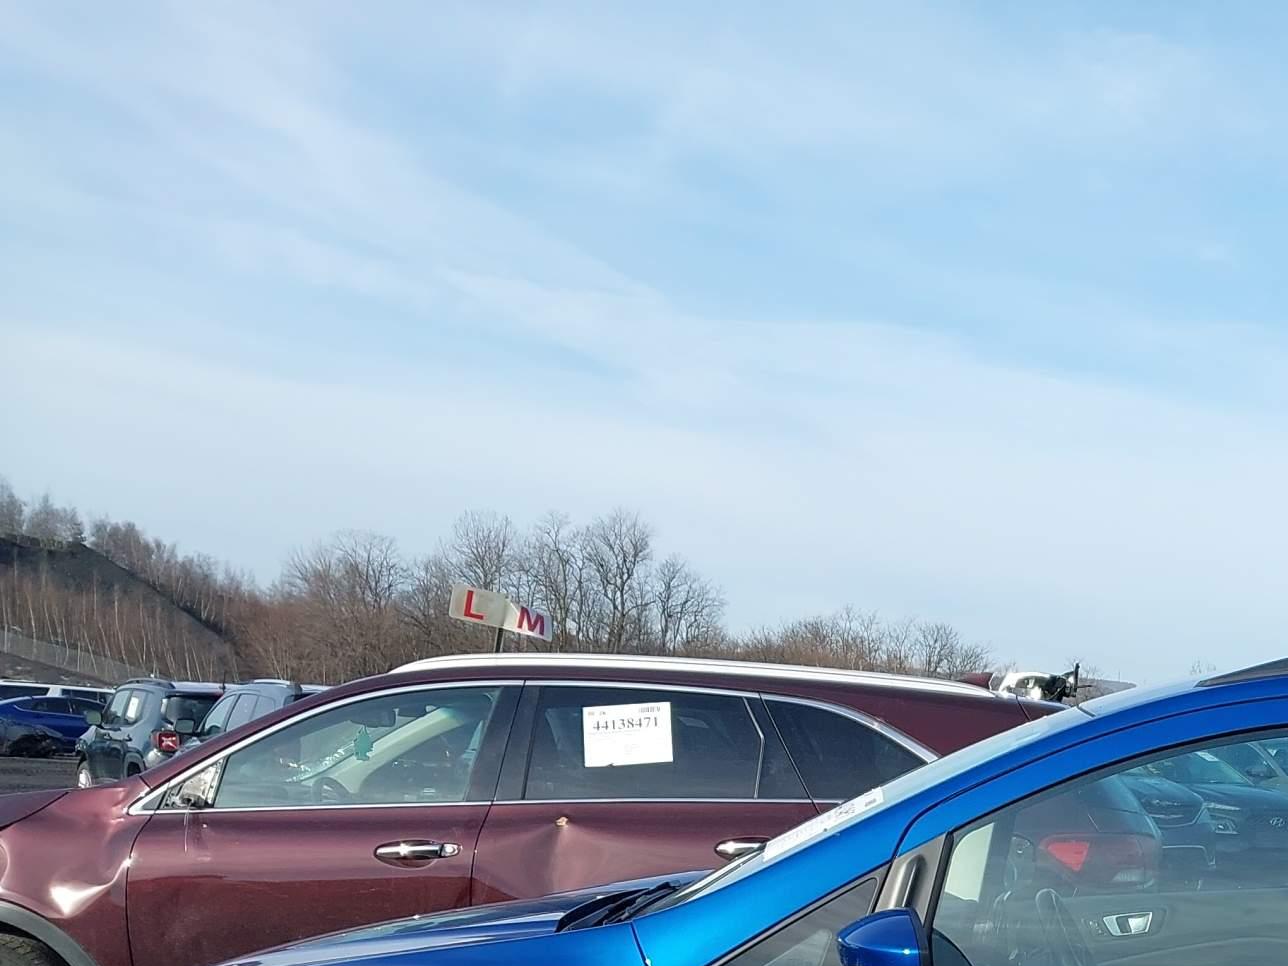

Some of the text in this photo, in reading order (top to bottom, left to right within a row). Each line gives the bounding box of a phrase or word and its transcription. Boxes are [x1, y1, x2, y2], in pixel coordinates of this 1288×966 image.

[464, 589, 484, 620] L
[517, 606, 545, 636] M
[593, 716, 659, 731] 44138471
